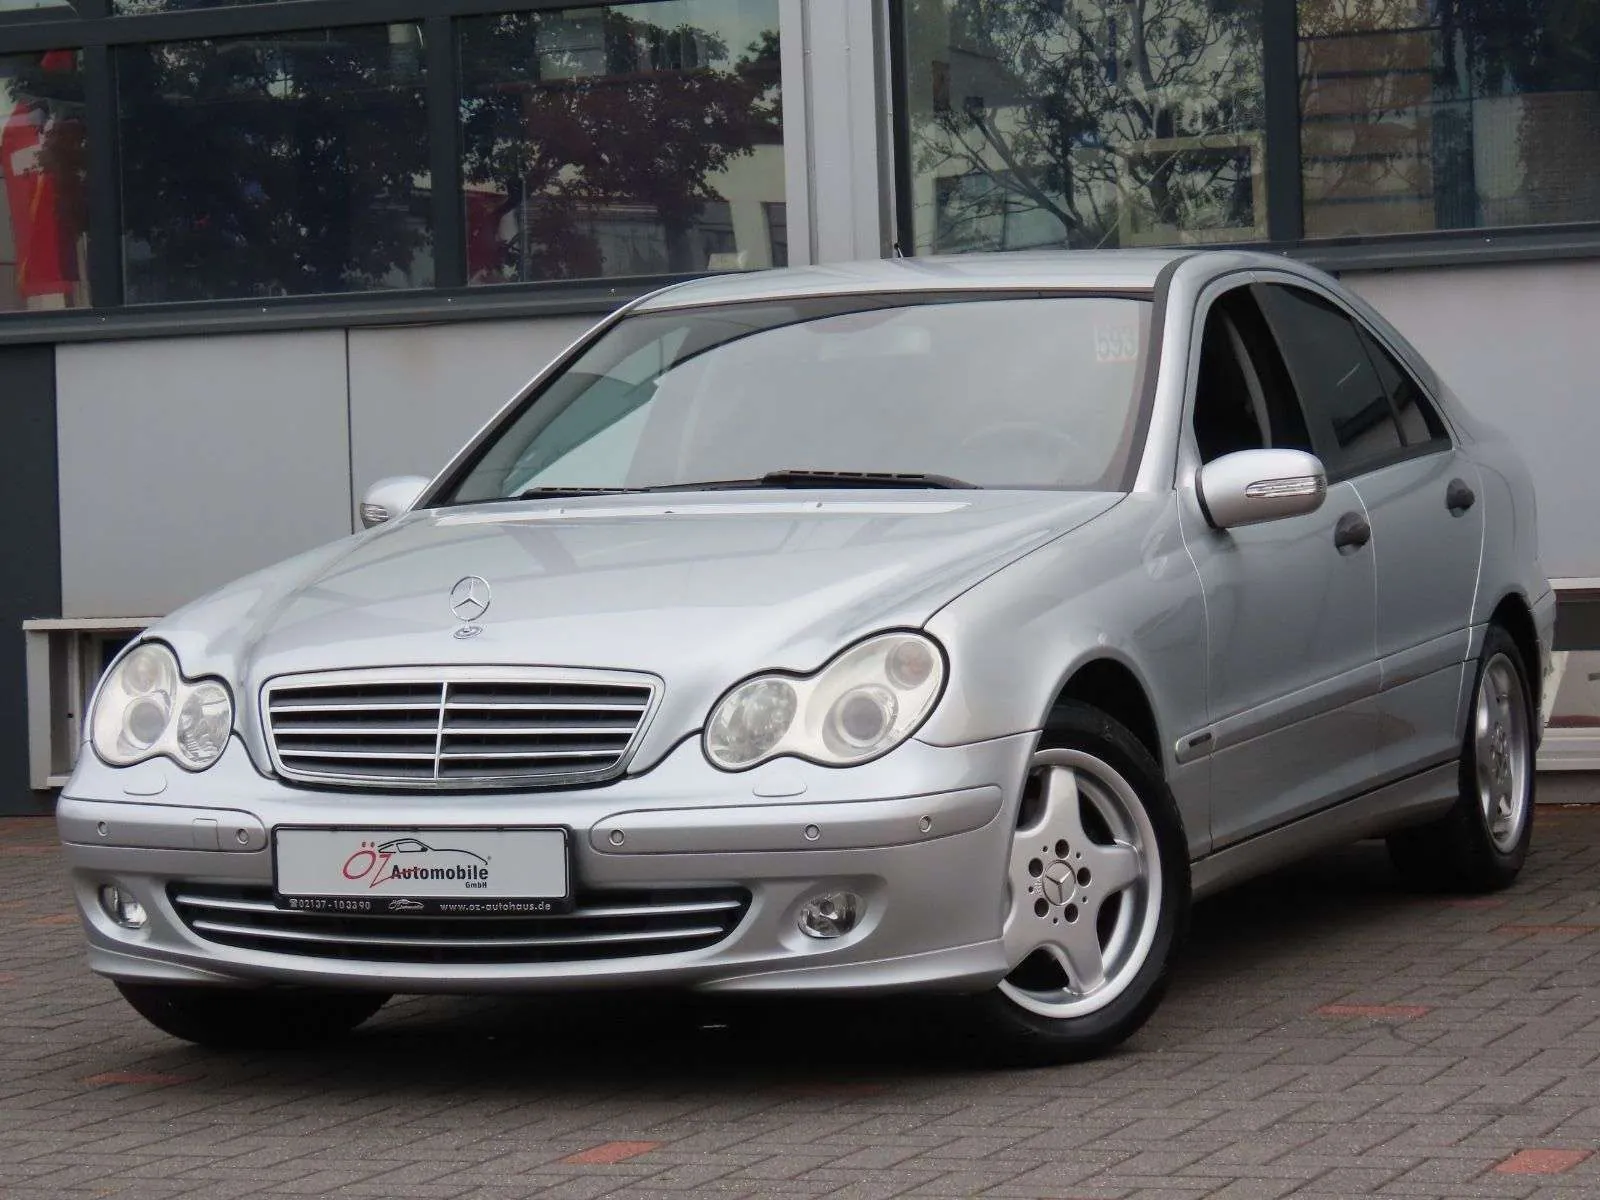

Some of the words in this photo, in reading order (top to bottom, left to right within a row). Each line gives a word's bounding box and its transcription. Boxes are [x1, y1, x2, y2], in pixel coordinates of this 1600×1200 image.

[391, 864, 489, 880] Automobile
[465, 881, 487, 889] GmbH
[440, 901, 551, 911] www.oz-autohaus.de
